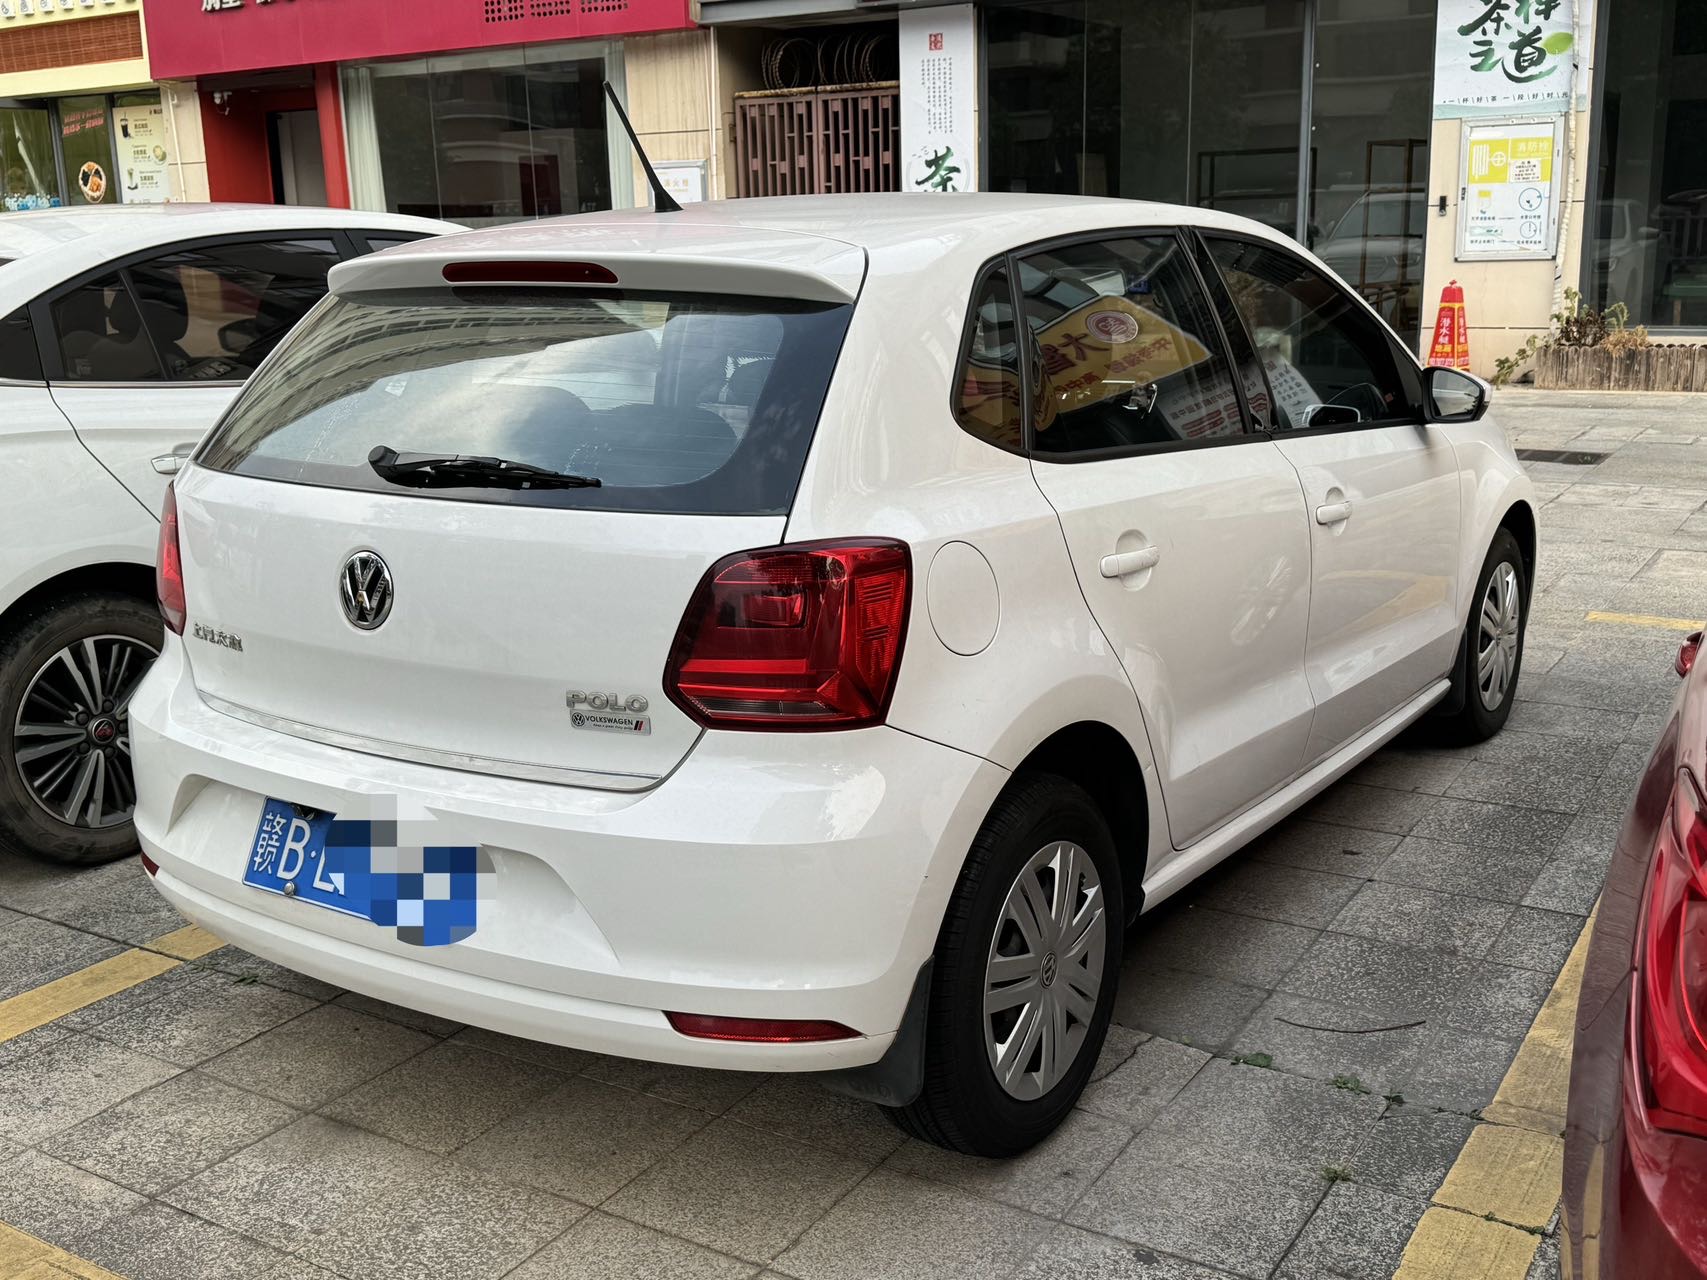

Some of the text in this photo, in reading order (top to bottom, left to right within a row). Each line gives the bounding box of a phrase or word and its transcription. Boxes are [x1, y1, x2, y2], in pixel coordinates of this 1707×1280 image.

[915, 145, 961, 192] 茶
[566, 690, 649, 713] POLO
[585, 715, 634, 726] VOLKSWAGEN
